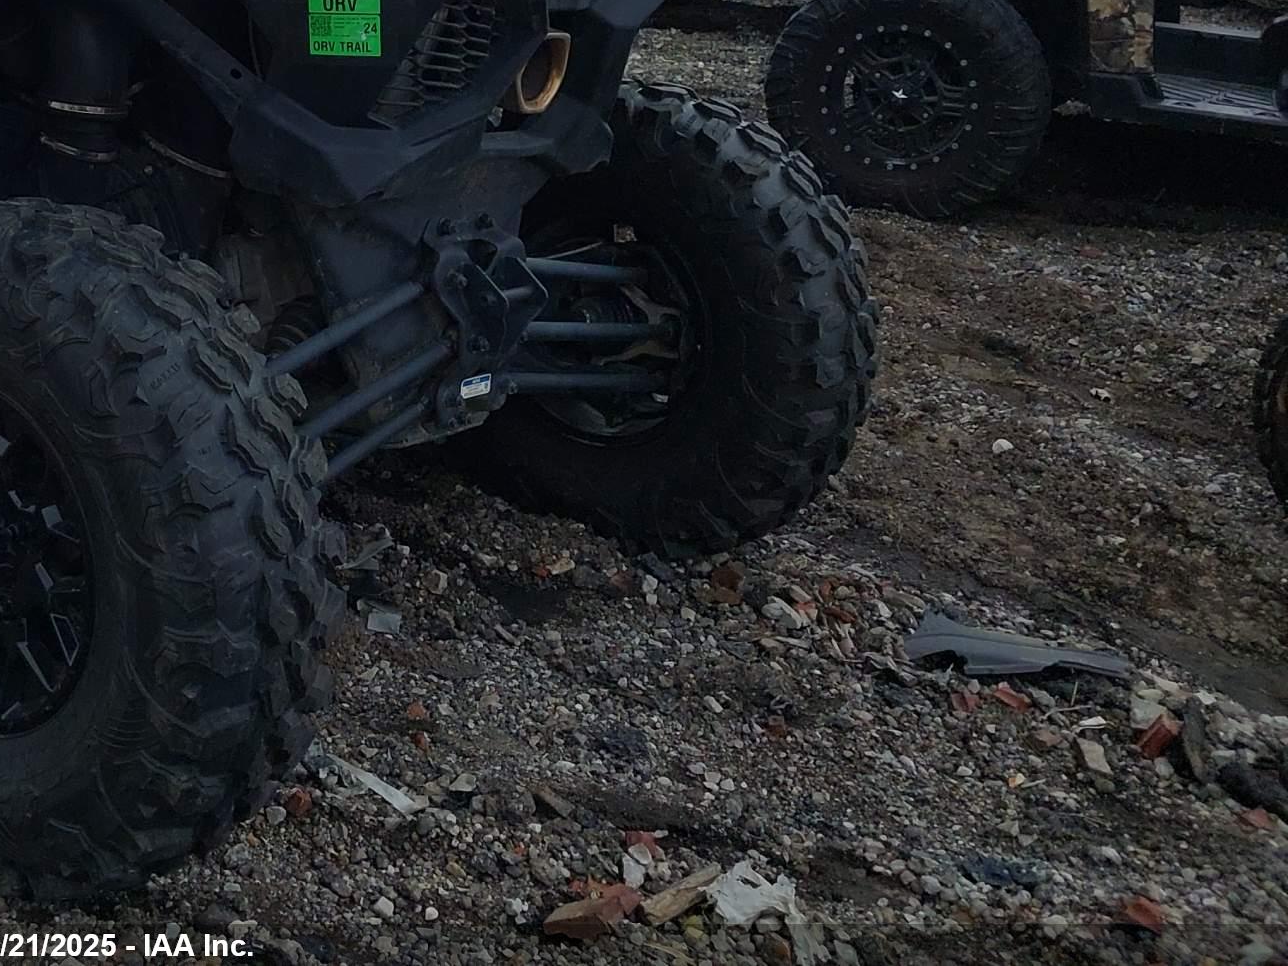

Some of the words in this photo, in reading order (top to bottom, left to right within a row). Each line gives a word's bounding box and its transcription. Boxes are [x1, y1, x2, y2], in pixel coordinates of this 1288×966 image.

[363, 22, 378, 35] 24
[313, 40, 336, 52] ORV
[340, 41, 372, 53] TRAIL
